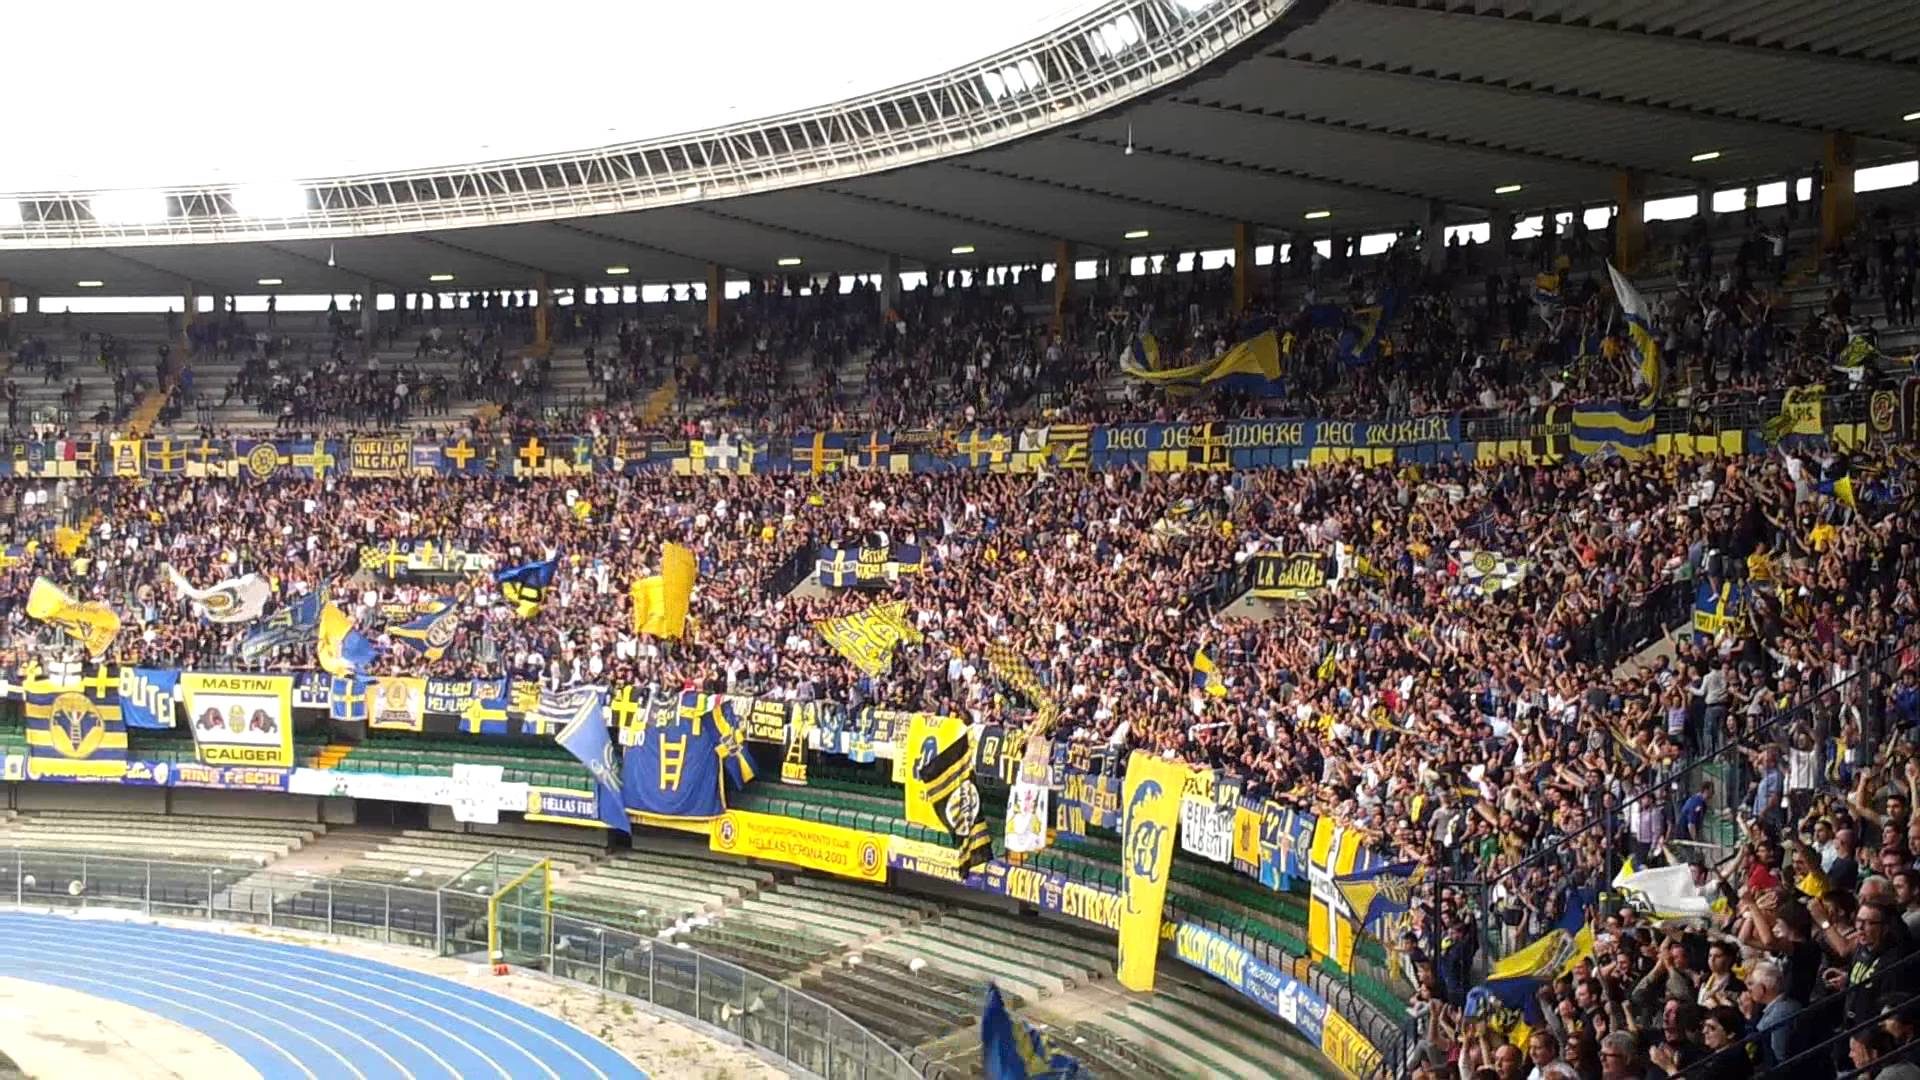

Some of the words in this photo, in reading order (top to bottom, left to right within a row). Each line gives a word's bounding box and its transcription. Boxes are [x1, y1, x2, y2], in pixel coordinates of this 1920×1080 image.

[202, 678, 272, 691] MASTINI
[118, 666, 176, 728] BUTEI
[543, 797, 576, 813] HELLAS
